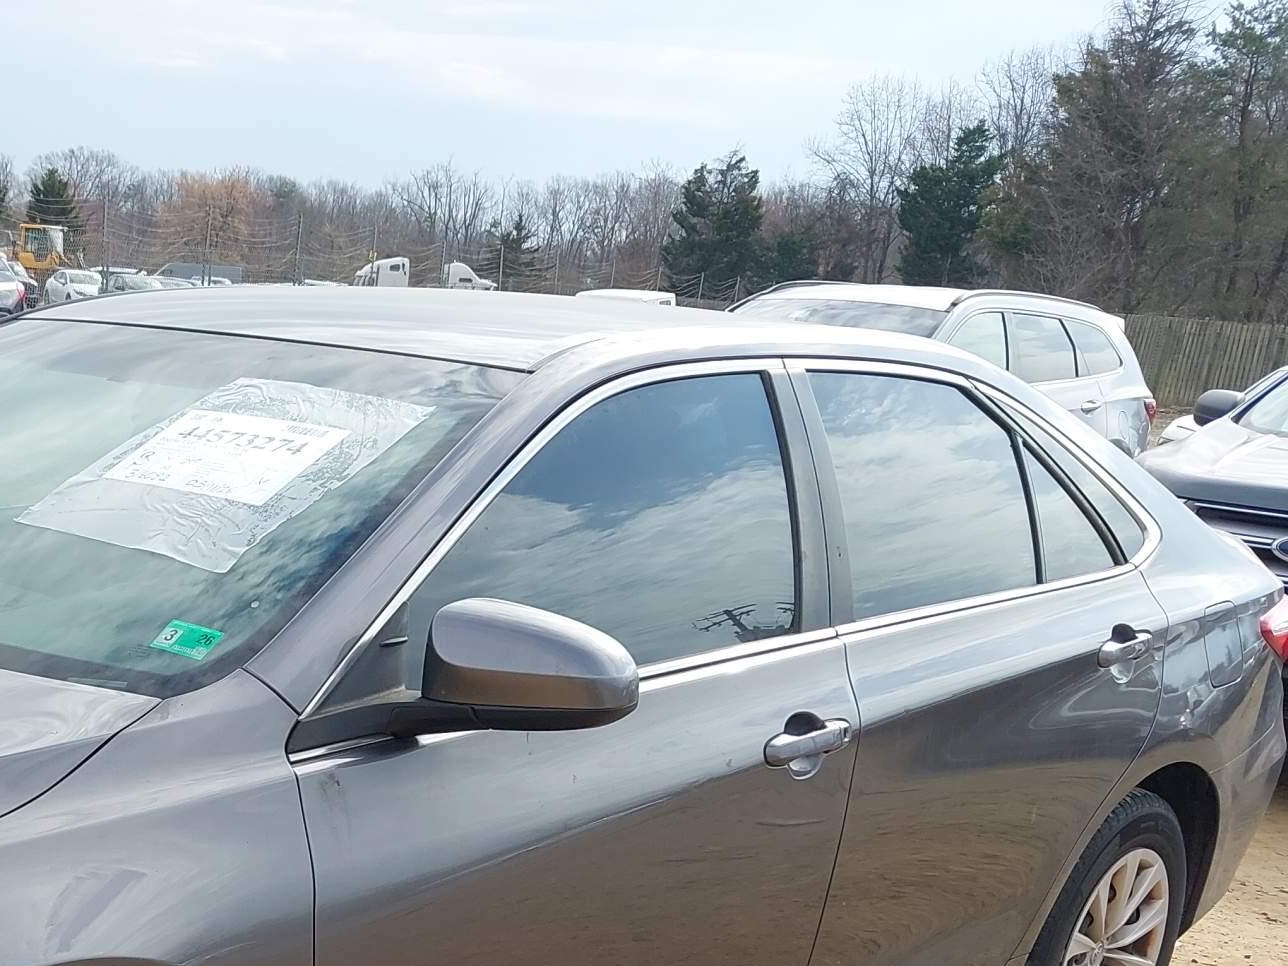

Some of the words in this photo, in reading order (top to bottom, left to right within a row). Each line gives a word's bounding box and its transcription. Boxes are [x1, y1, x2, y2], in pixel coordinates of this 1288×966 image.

[177, 426, 310, 456] 44573274
[164, 629, 178, 641] 3
[196, 633, 216, 646] 26
